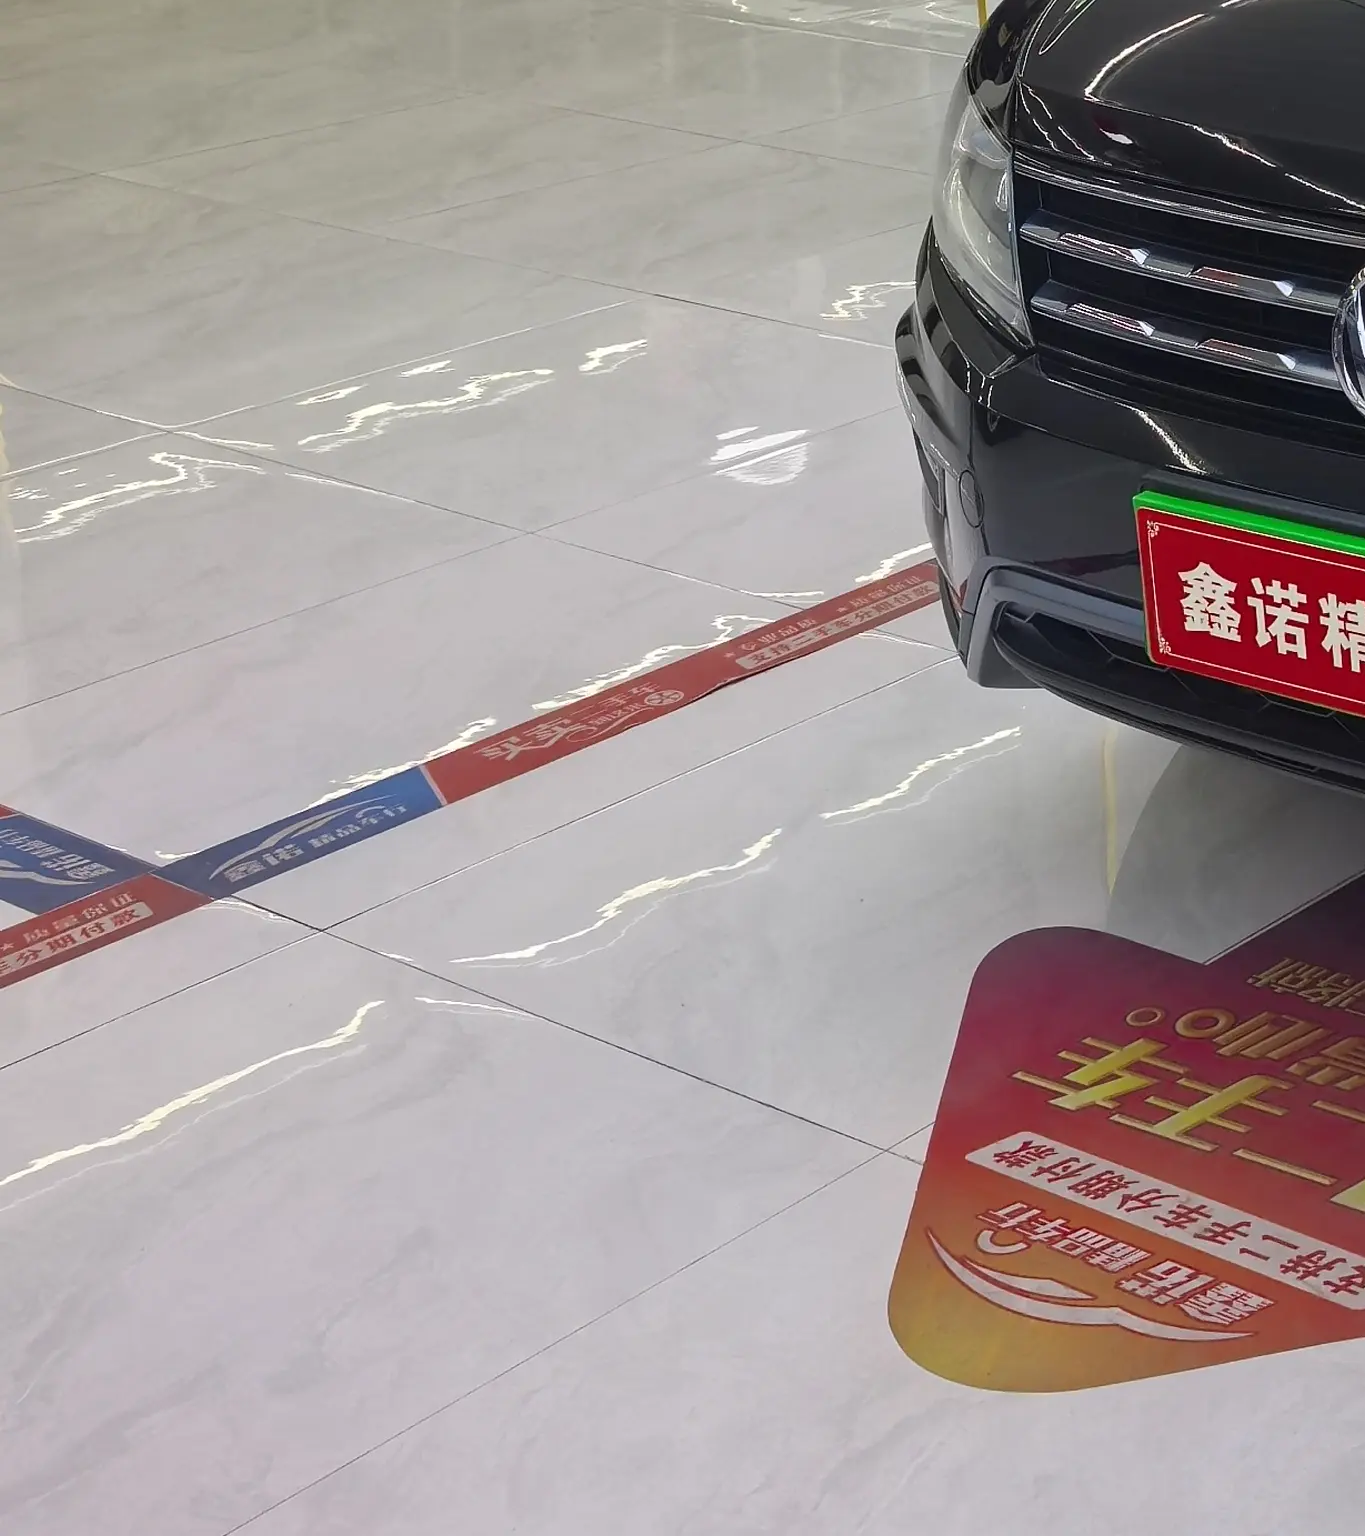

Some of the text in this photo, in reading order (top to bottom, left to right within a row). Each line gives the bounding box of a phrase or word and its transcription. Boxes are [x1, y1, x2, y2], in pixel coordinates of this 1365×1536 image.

[975, 1200, 1277, 1330] 鑫诺 精品车行
